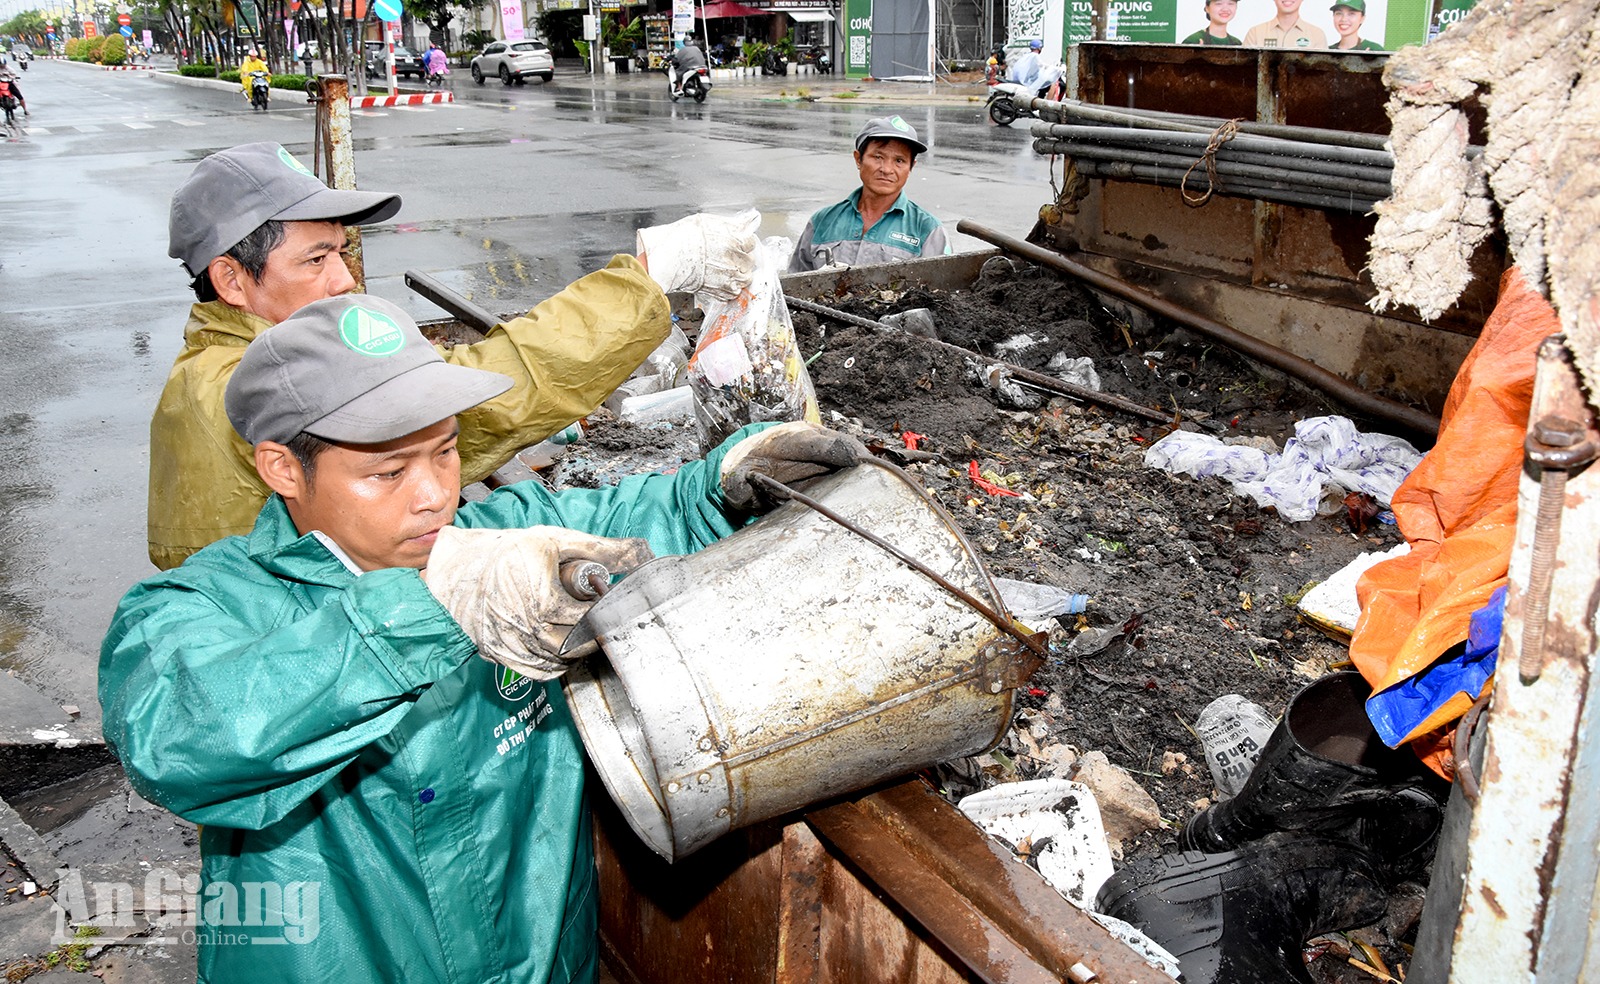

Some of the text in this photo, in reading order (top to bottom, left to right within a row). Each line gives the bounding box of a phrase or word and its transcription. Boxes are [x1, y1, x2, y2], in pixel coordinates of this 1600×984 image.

[1114, 2, 1153, 13] DỤNG
[850, 17, 861, 30] CƠ
[365, 339, 383, 350] CIC
[505, 684, 519, 696] CIC
[493, 722, 504, 738] CT
[504, 715, 517, 731] CP
[508, 730, 526, 743] THỊ
